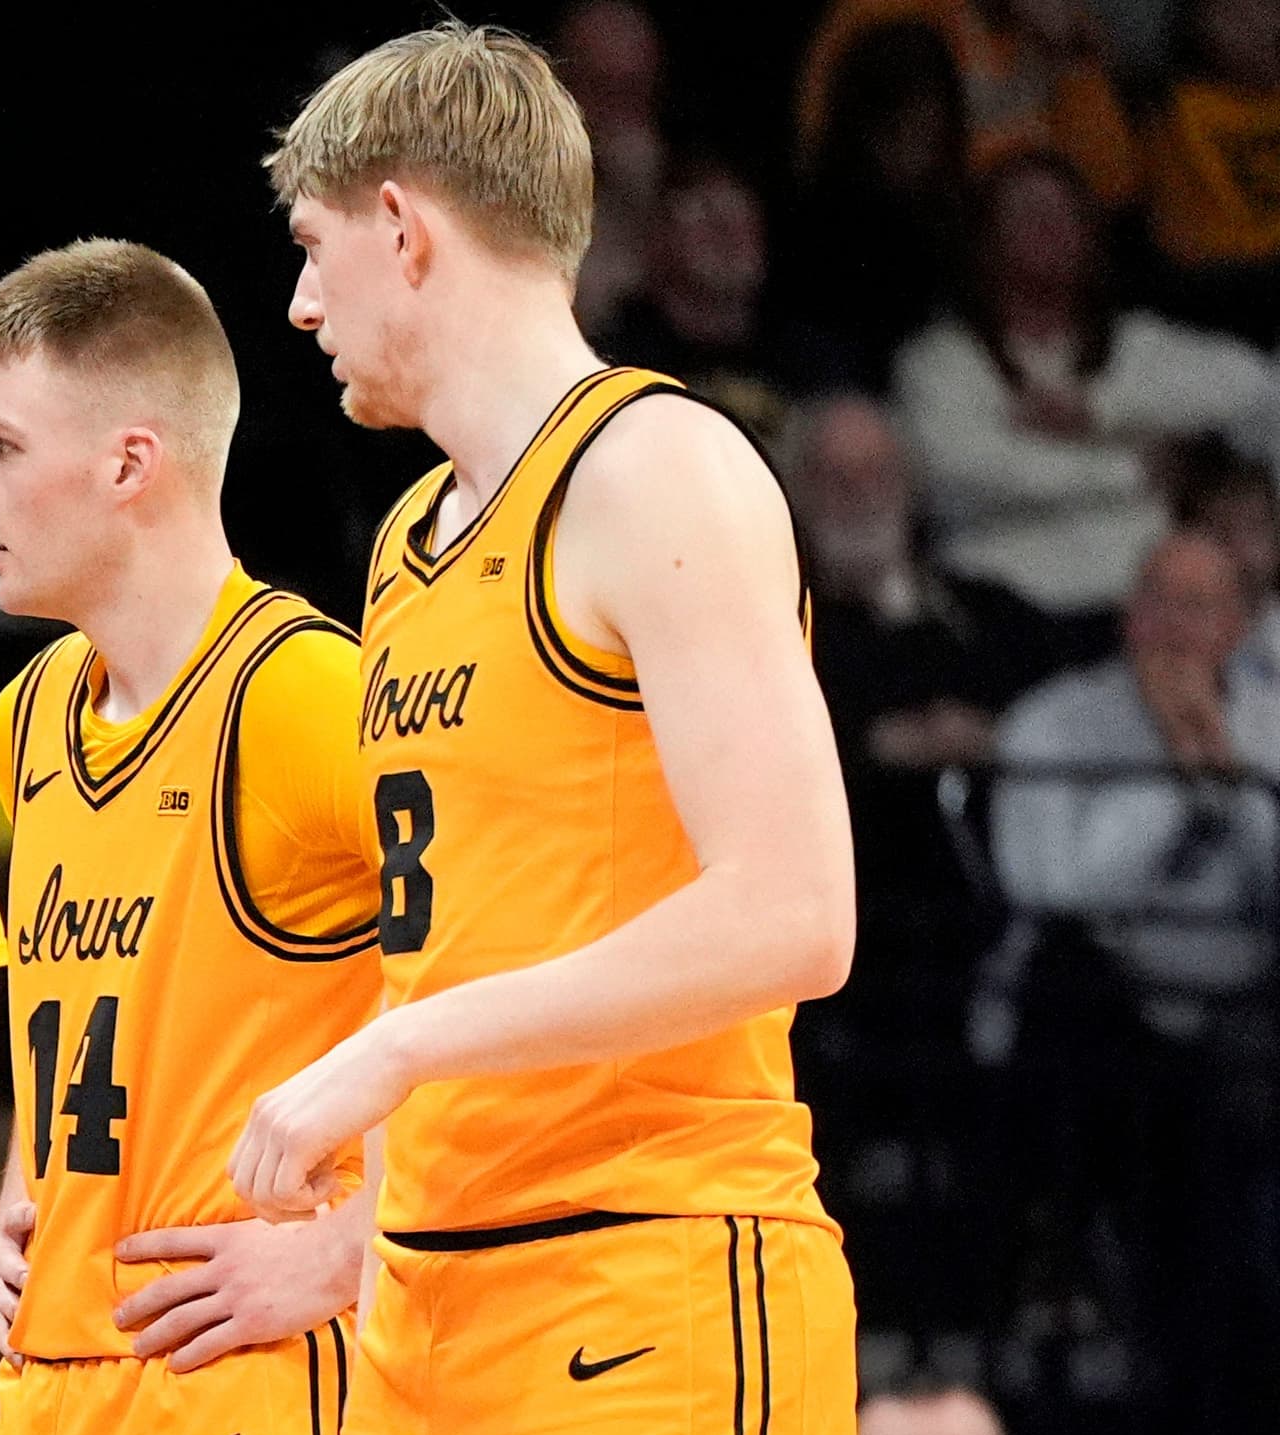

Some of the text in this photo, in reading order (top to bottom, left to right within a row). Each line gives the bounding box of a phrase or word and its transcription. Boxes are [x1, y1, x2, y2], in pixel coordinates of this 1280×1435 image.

[357, 646, 477, 754] Iowa
[19, 864, 155, 965] Iowa
[374, 768, 435, 956] 8
[28, 995, 127, 1180] 14
